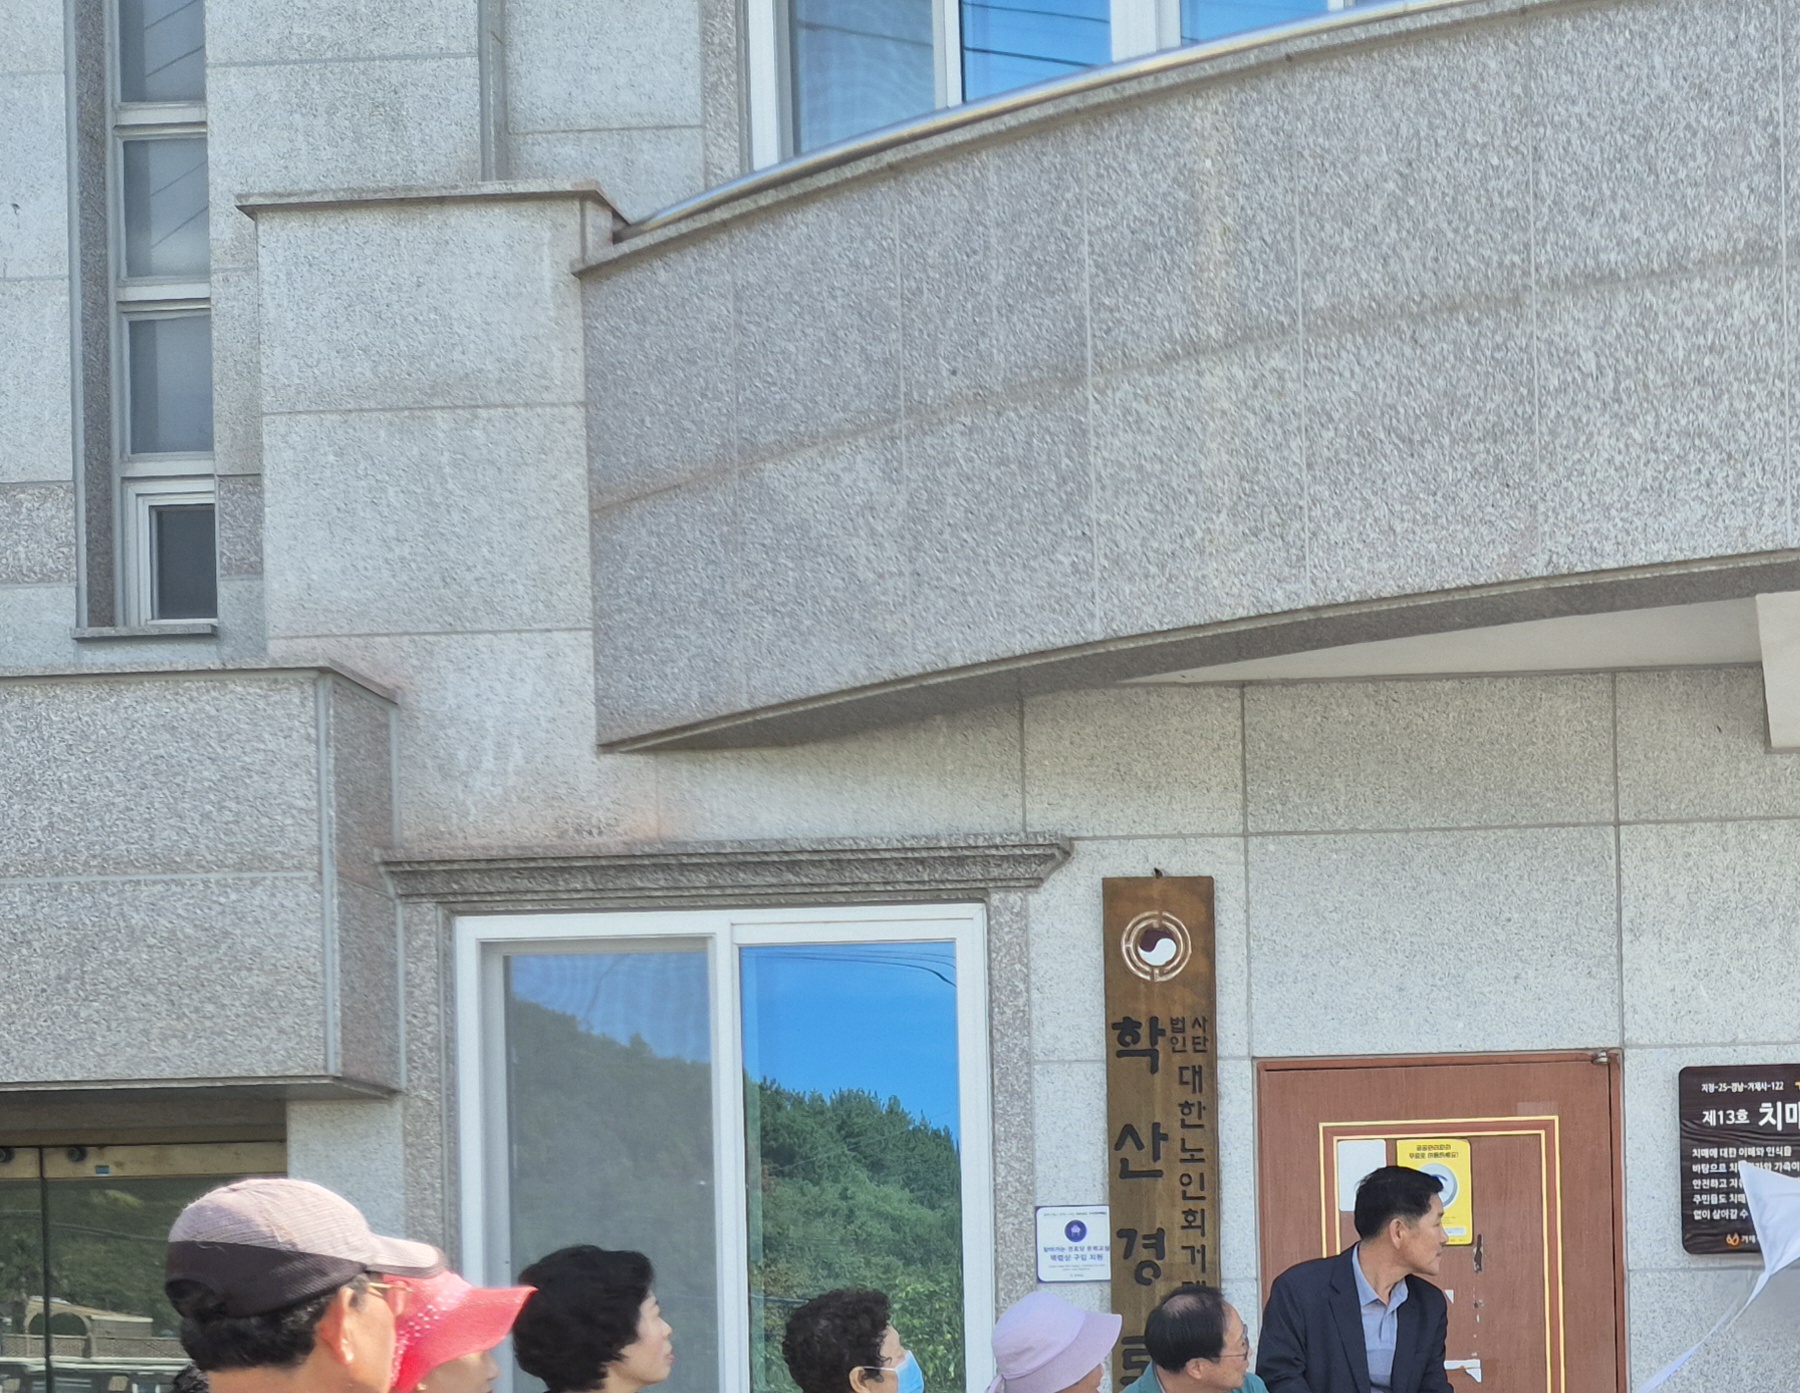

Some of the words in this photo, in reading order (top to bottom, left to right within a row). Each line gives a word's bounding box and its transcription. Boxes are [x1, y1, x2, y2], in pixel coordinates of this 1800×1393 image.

[1702, 1109, 1750, 1127] 제13호
[1692, 1148, 1718, 1158] 치매에
[1720, 1147, 1737, 1158] 대한
[1738, 1146, 1765, 1158] 이해와
[1766, 1146, 1792, 1157] 인식을
[1692, 1163, 1727, 1173] 바탕으로
[1773, 1161, 1800, 1172] 가족이
[1178, 1065, 1206, 1288] 대한노인회거
[1692, 1179, 1727, 1189] 안전하고
[1692, 1194, 1727, 1205] 주민들도
[1693, 1209, 1710, 1220] 없이
[1712, 1208, 1738, 1219] 살아갈
[1740, 1209, 1748, 1219] 수
